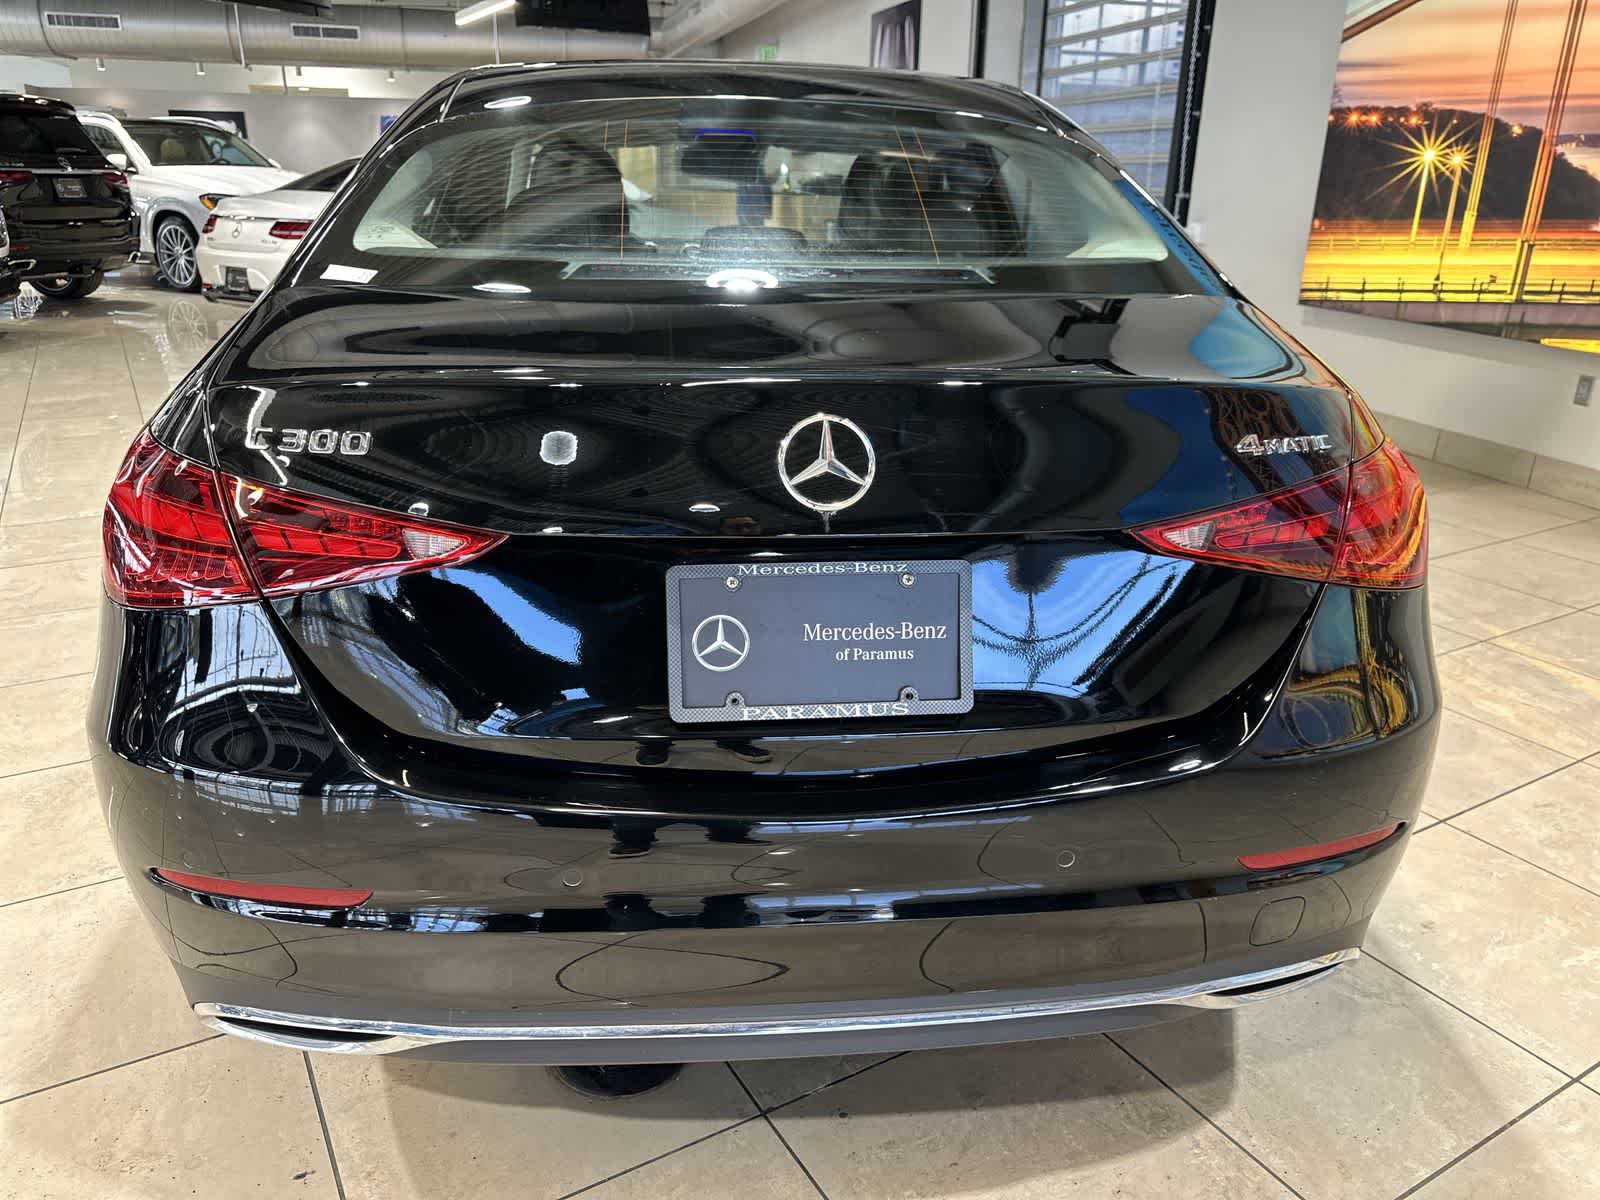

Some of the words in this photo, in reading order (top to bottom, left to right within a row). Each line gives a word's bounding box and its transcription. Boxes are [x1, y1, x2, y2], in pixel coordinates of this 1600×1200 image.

[277, 428, 372, 456] 300
[1235, 433, 1333, 456] 4MATIC
[737, 561, 909, 576] Mercedes-Benz
[803, 622, 947, 642] Mercedes-Benz
[835, 649, 851, 661] of
[853, 648, 914, 661] Paramus
[740, 702, 910, 721] PARAMUS
